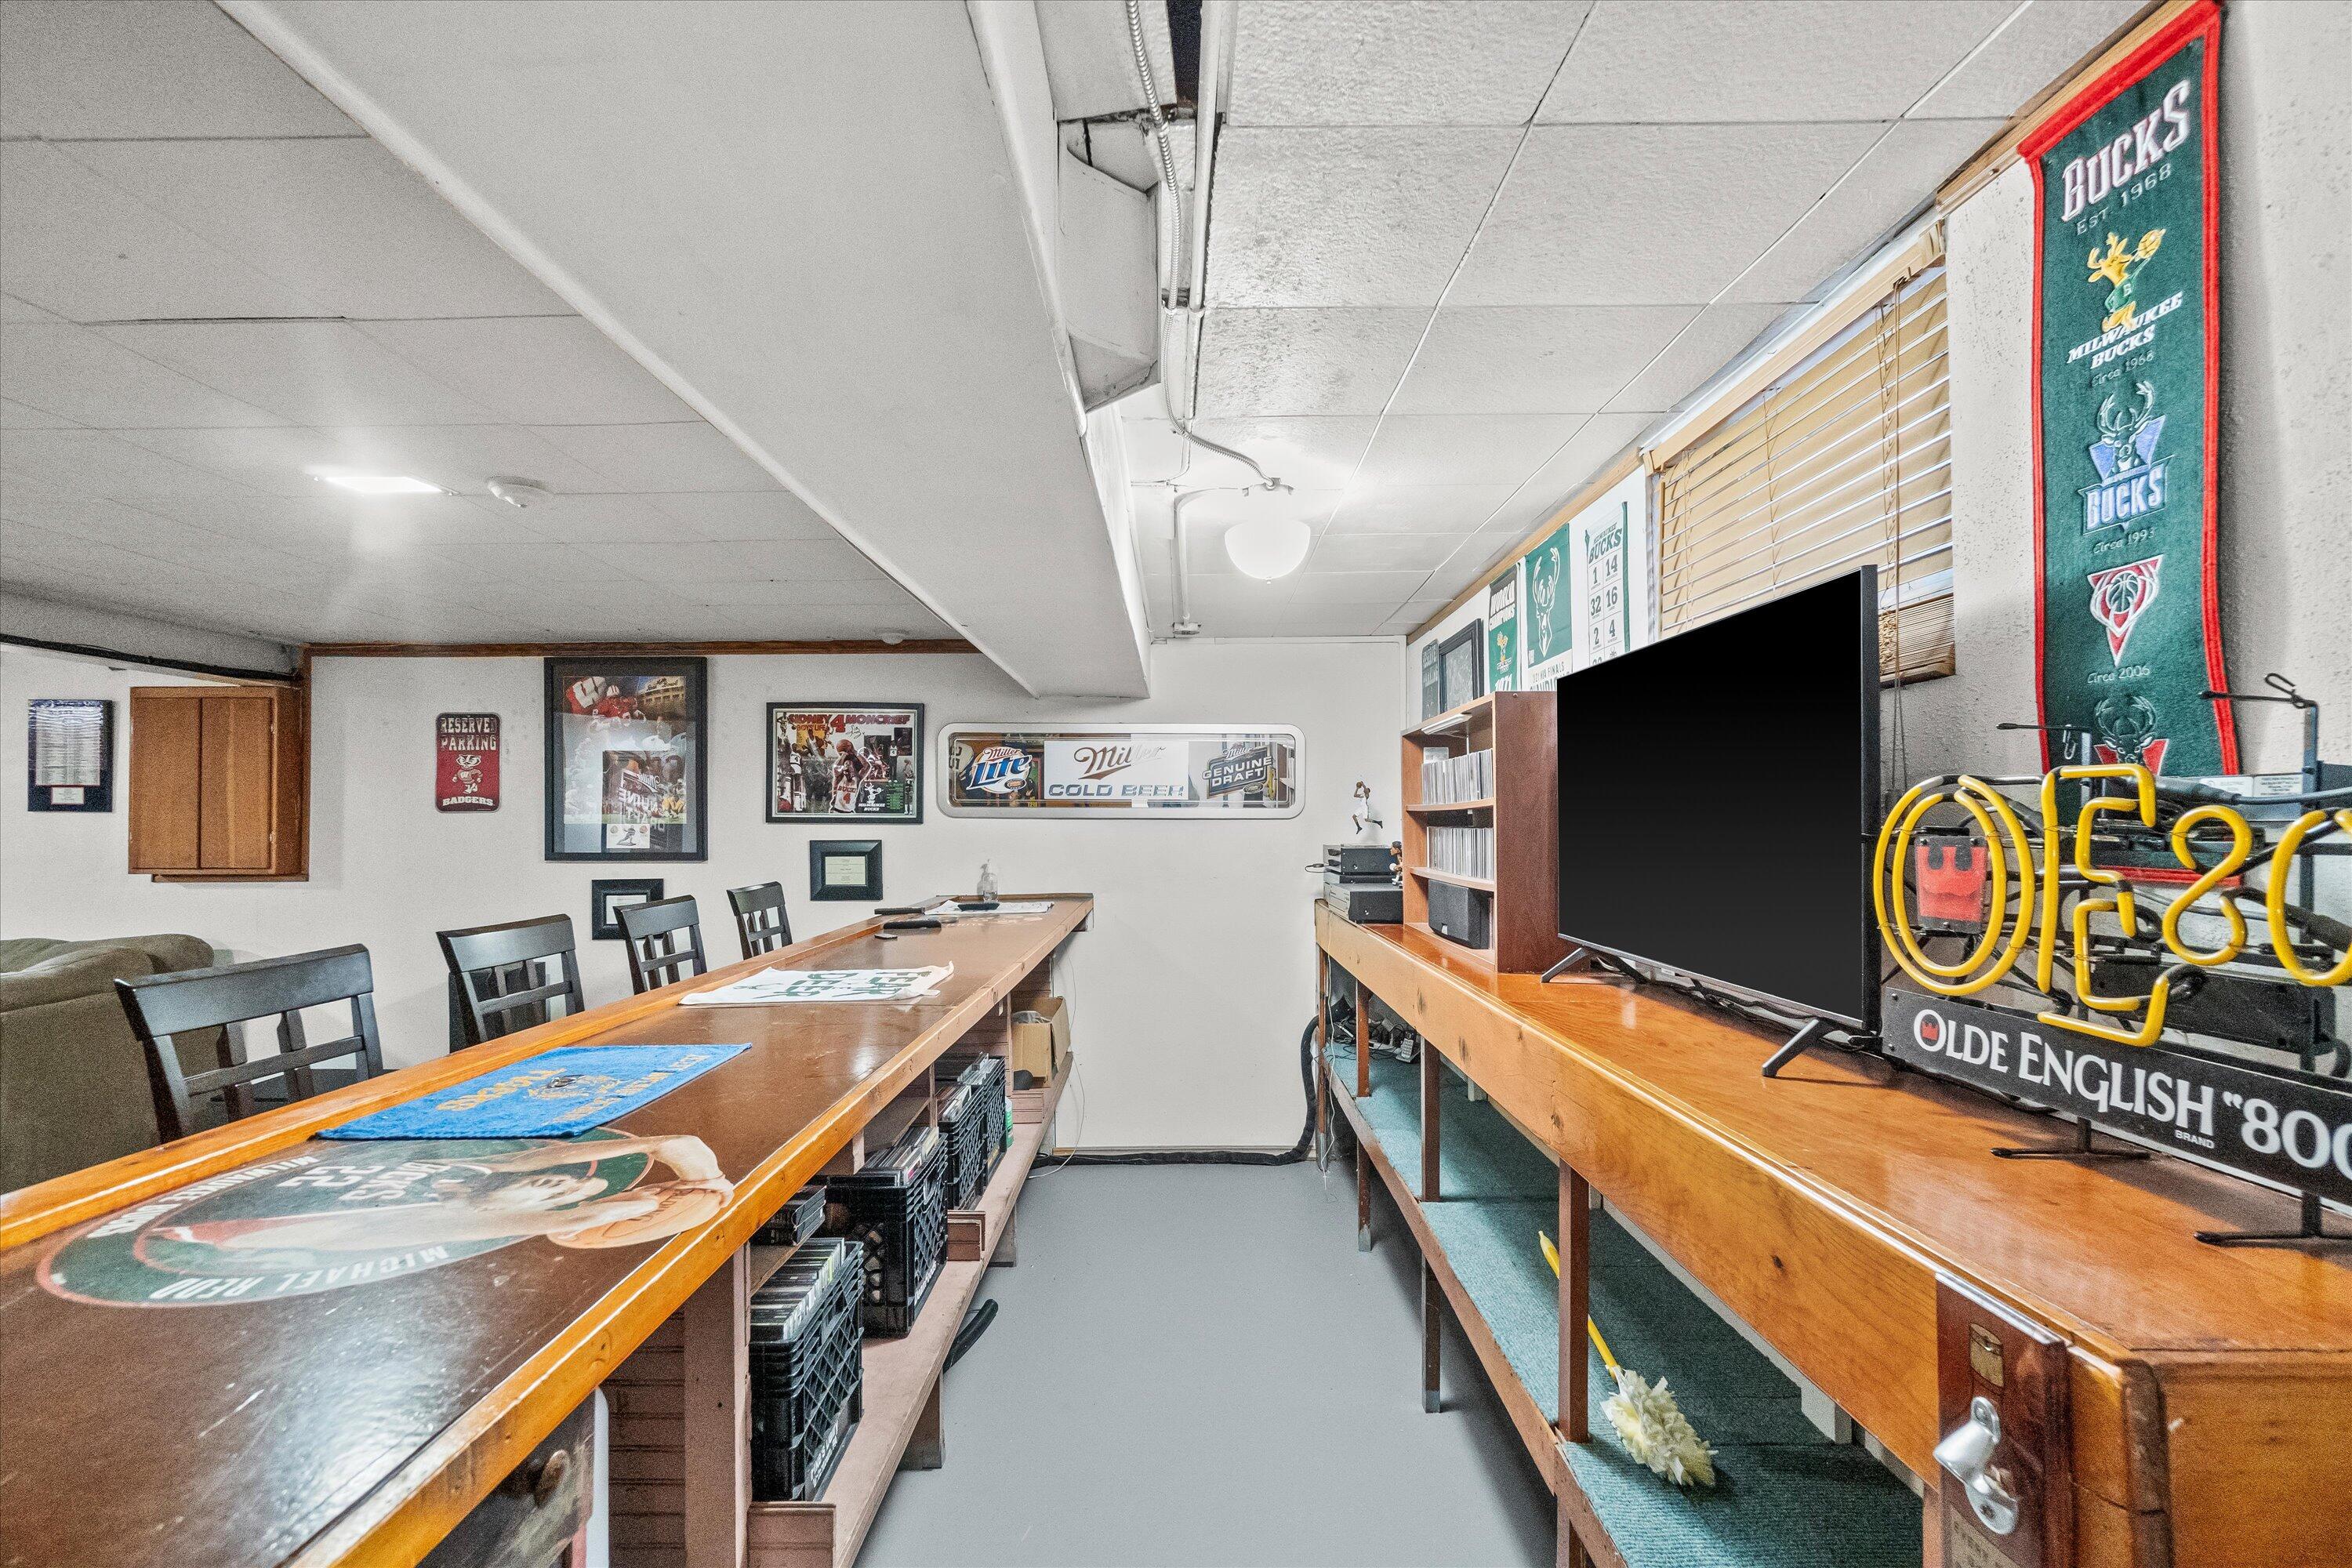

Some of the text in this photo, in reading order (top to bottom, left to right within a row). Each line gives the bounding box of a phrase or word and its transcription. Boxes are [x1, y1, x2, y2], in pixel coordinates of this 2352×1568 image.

[2061, 78, 2190, 221] BUCKS
[2077, 163, 2172, 236] EST 1968
[2066, 291, 2183, 364] MILWAUKEE
[2090, 324, 2156, 369] BUCKS
[2125, 350, 2154, 372] 1968
[2086, 463, 2164, 531] BUCKS
[1589, 528, 1622, 564] BUCKS
[2093, 528, 2155, 554] Circa 1993
[1592, 567, 1598, 584] 1
[1606, 554, 1618, 576] 14
[1590, 595, 1602, 616] 32
[1606, 586, 1618, 608] 16
[1593, 627, 1599, 645] 2
[1609, 619, 1616, 637] 4
[2087, 665, 2151, 684] Circa 2006
[441, 717, 497, 733] RESERVED
[788, 714, 833, 724] SIDNEY
[830, 714, 846, 733] 4
[846, 714, 910, 725] MONCRIEF
[441, 735, 496, 751] PARKING
[983, 748, 1022, 760] Miller
[1223, 747, 1254, 758] Miller
[967, 755, 1033, 789] Lite
[1203, 756, 1272, 779] GENUINE
[1211, 768, 1264, 787] DRAFT
[442, 796, 494, 807] BADGERS
[843, 793, 851, 804] 4
[1048, 784, 1184, 797] COLD BEER
[753, 972, 859, 999] DEER
[832, 971, 932, 998] FEAR
[1913, 1009, 2009, 1074] OLDE
[2017, 1030, 2216, 1137] ENGLISH
[2175, 1128, 2216, 1150] BRAND
[149, 1245, 450, 1300] MICHAEL REDD
